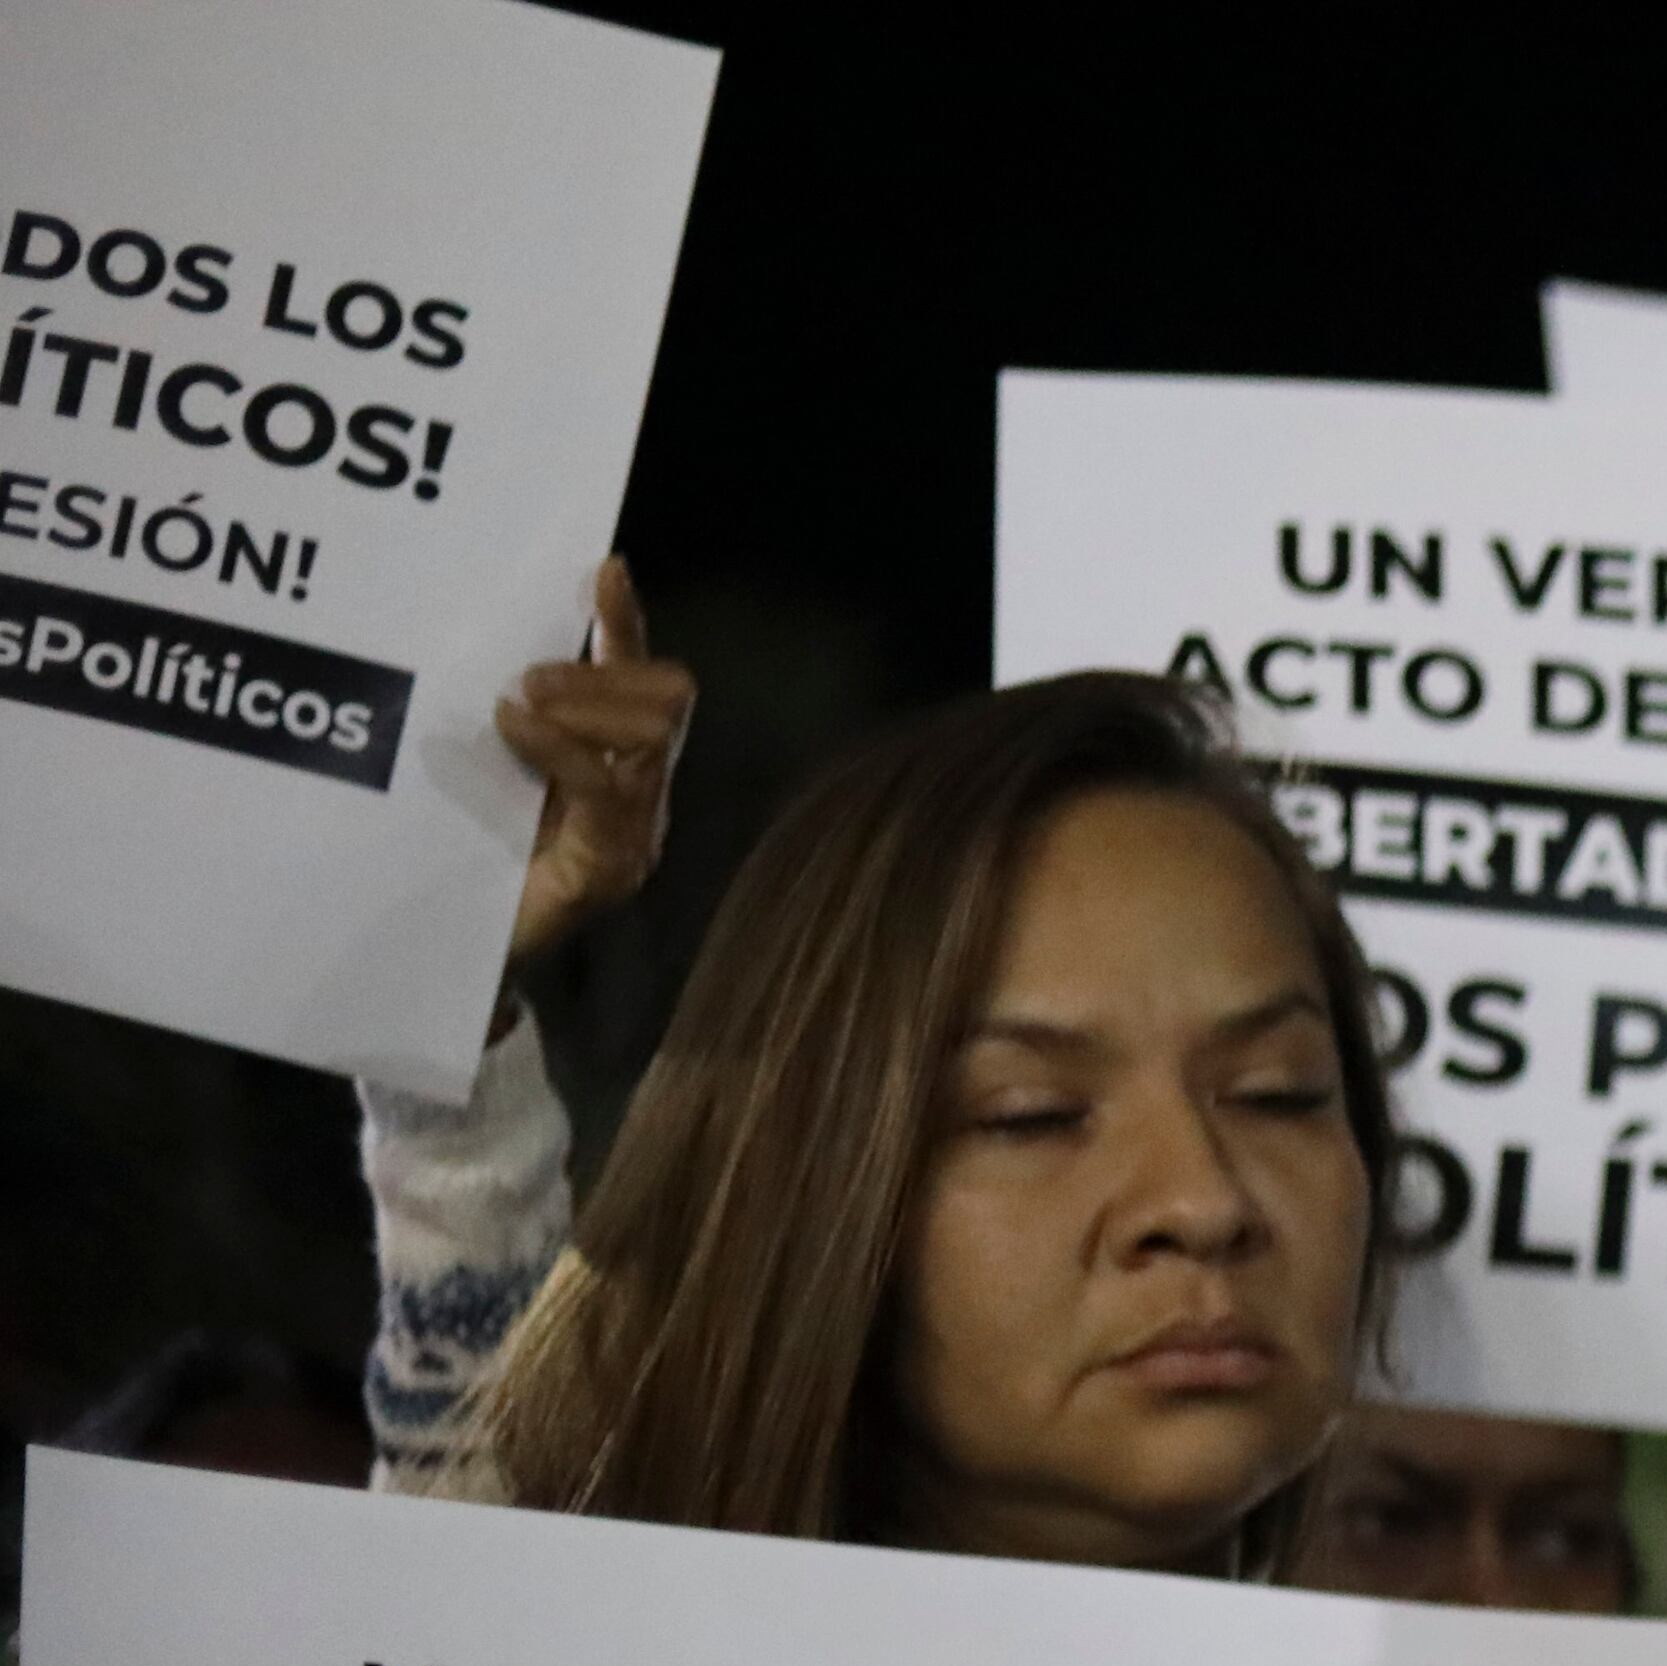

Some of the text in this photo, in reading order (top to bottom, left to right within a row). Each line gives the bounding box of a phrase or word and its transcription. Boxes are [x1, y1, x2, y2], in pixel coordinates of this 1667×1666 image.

[2, 208, 470, 370] DOS LOS
[0, 305, 454, 502] ÍTICOS!
[0, 470, 320, 603] ESIÓN!
[1278, 521, 1442, 604] UN
[1163, 630, 1486, 723] ACTO
[1366, 965, 1530, 1086] OS
